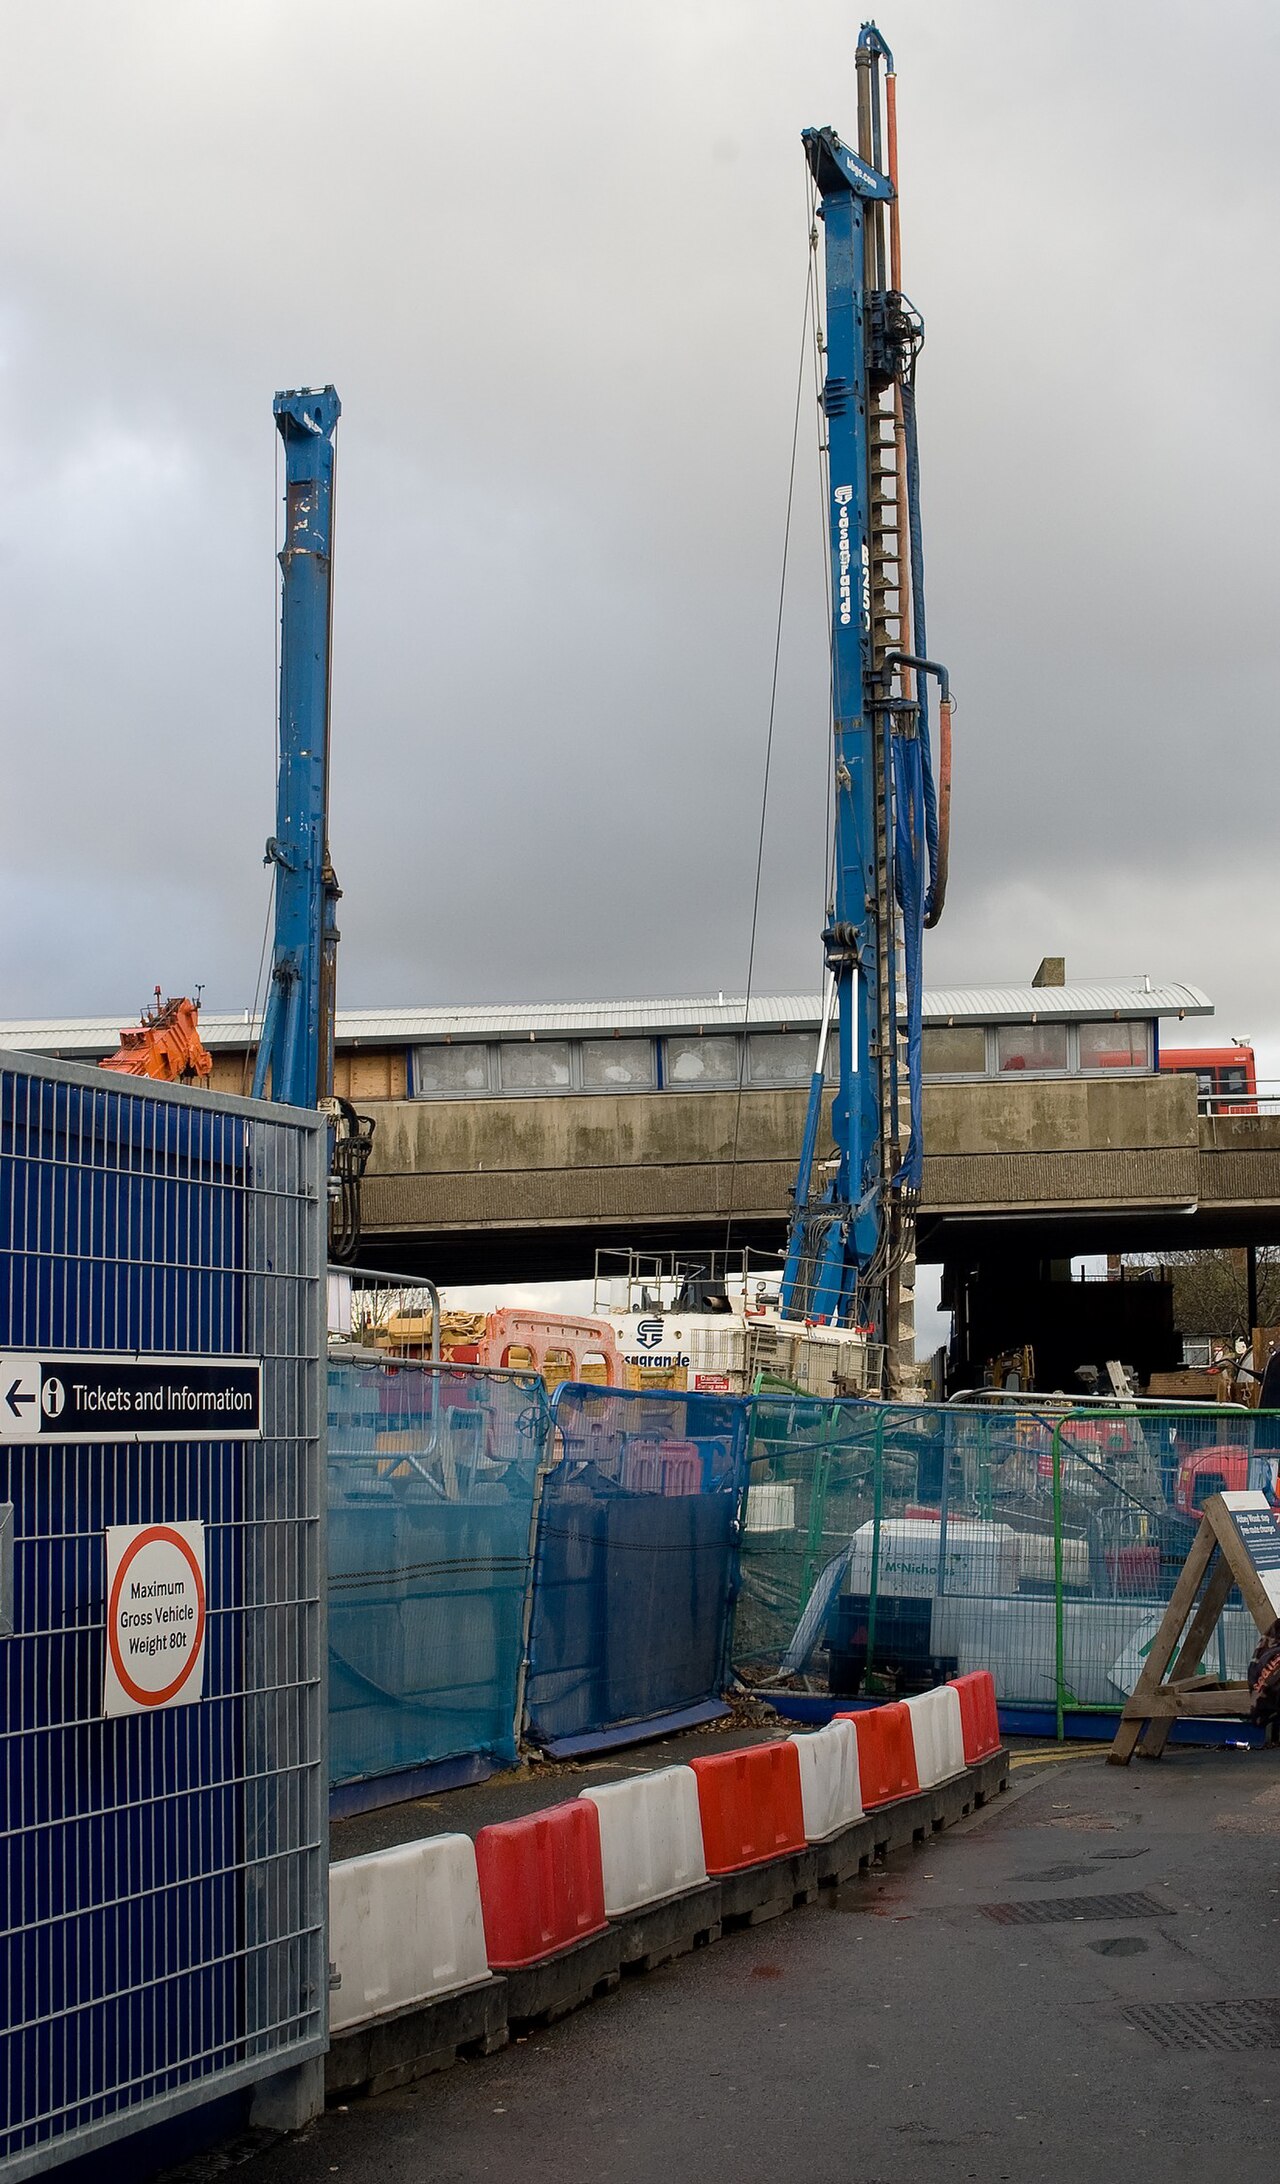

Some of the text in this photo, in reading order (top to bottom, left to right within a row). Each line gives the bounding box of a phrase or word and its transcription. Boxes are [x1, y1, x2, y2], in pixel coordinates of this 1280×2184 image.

[839, 506, 851, 625] casagrande
[625, 1351, 690, 1367] sagrande
[73, 1384, 252, 1412] Tickets and Information
[885, 1562, 955, 1576] McNichoas
[130, 1580, 185, 1600] Maximum
[120, 1605, 194, 1628] Gross Vehicle
[129, 1634, 187, 1656] Weight 80t
